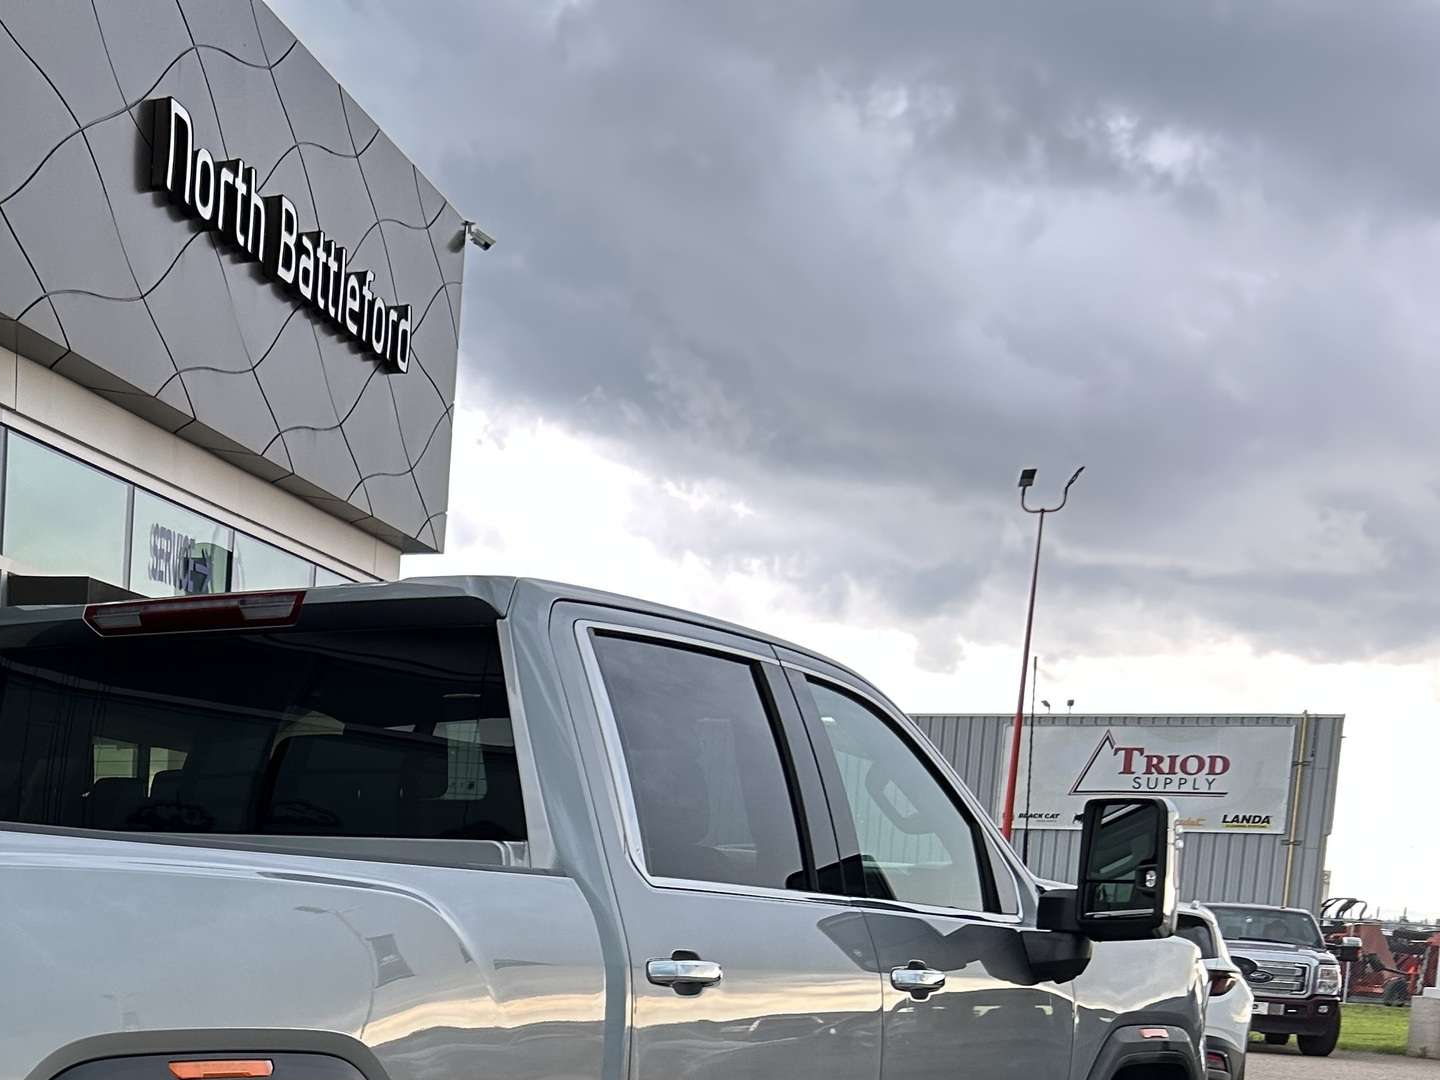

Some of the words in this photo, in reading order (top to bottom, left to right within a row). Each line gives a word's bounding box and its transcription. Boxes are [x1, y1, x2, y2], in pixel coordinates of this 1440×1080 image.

[164, 97, 265, 262] North
[276, 194, 412, 373] Battleford
[1113, 747, 1230, 775] TRIOD
[1132, 777, 1216, 790] SUPPLY
[1221, 814, 1271, 825] LANDA
